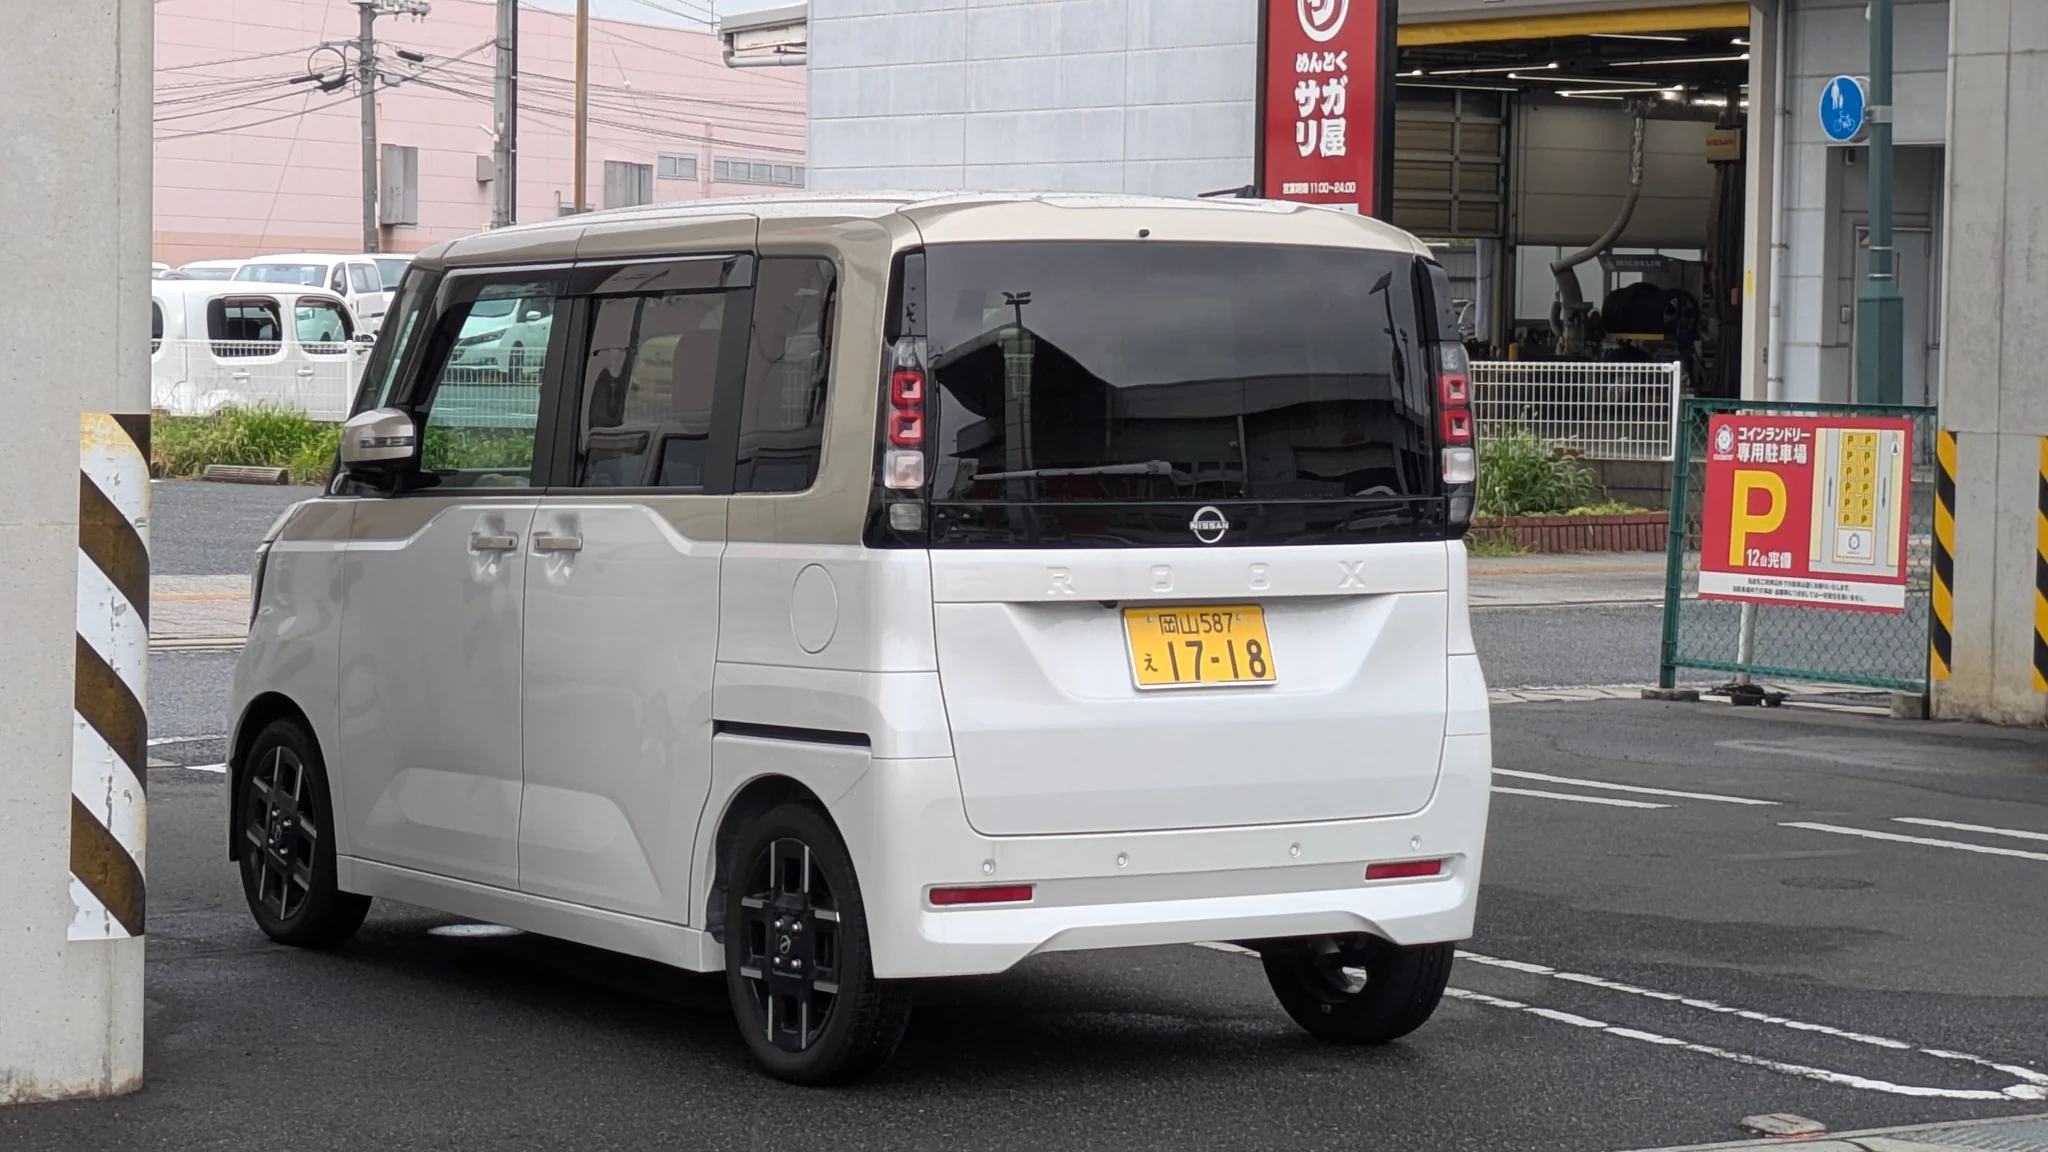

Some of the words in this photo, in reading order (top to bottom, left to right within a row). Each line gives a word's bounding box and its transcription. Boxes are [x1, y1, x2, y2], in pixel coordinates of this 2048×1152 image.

[1738, 427, 1811, 442] コインランドリー
[1736, 442, 1807, 465] 専用駐車場
[1189, 520, 1229, 530] NISSAN
[1729, 469, 1787, 566] P
[1167, 638, 1267, 681] 17-18
